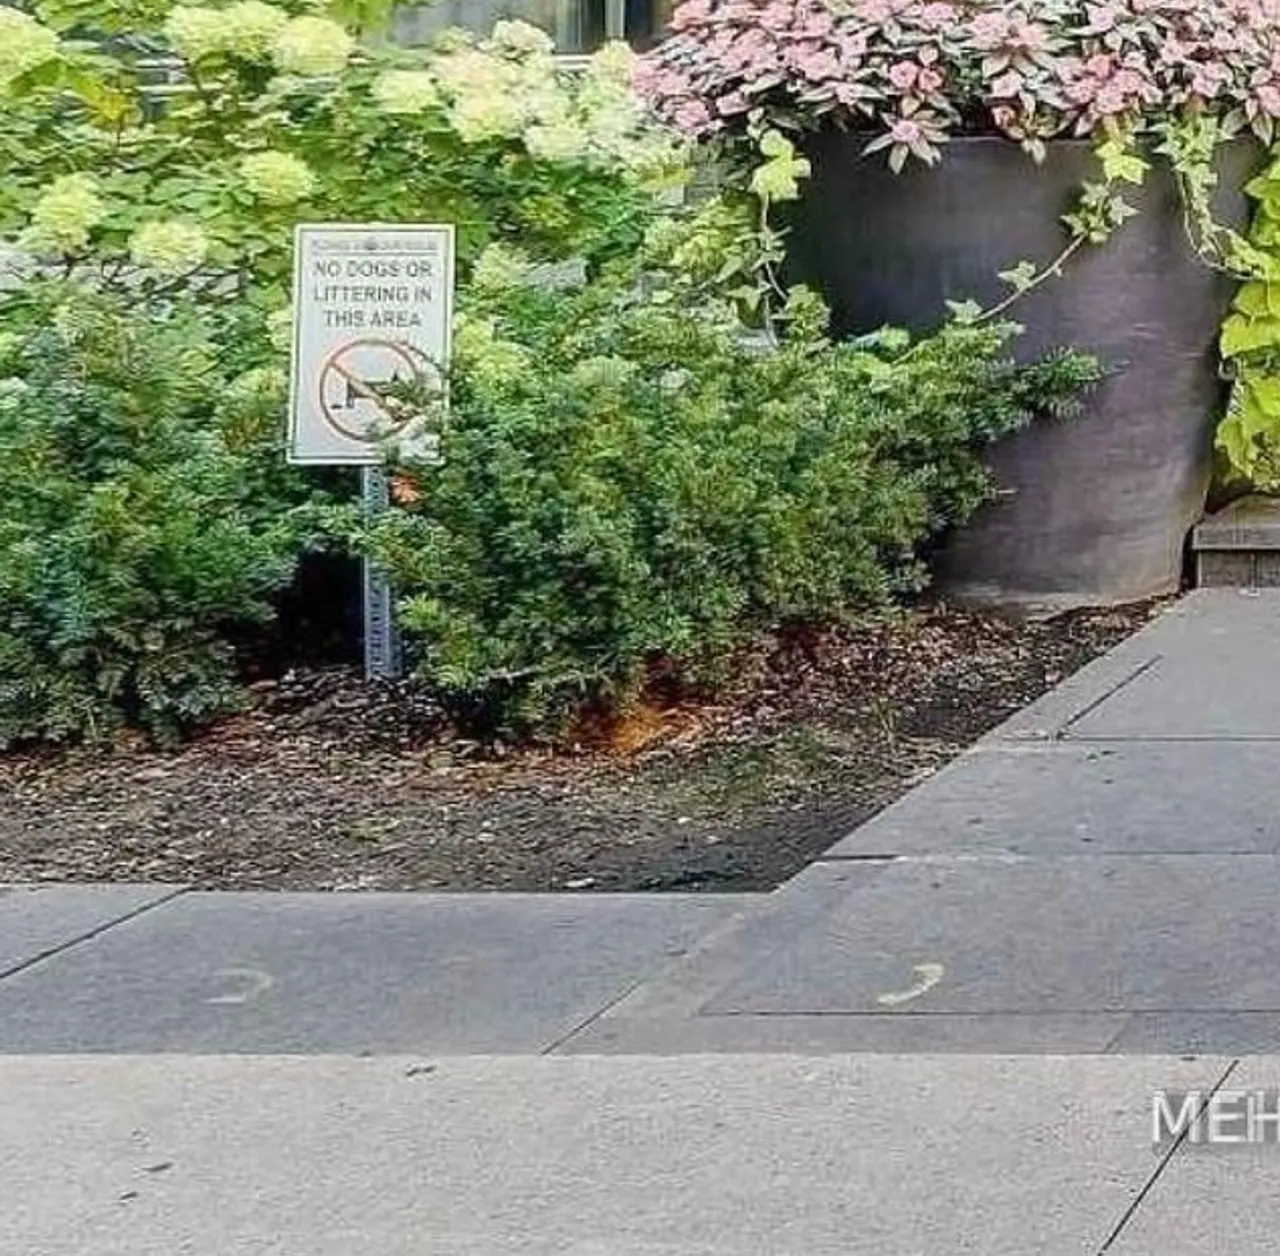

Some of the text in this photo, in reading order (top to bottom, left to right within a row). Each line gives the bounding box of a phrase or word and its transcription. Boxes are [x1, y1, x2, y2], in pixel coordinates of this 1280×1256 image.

[315, 260, 433, 278] NO DOGS OR
[313, 285, 433, 303] LITTERING IN
[323, 310, 423, 328] THIS AREA
